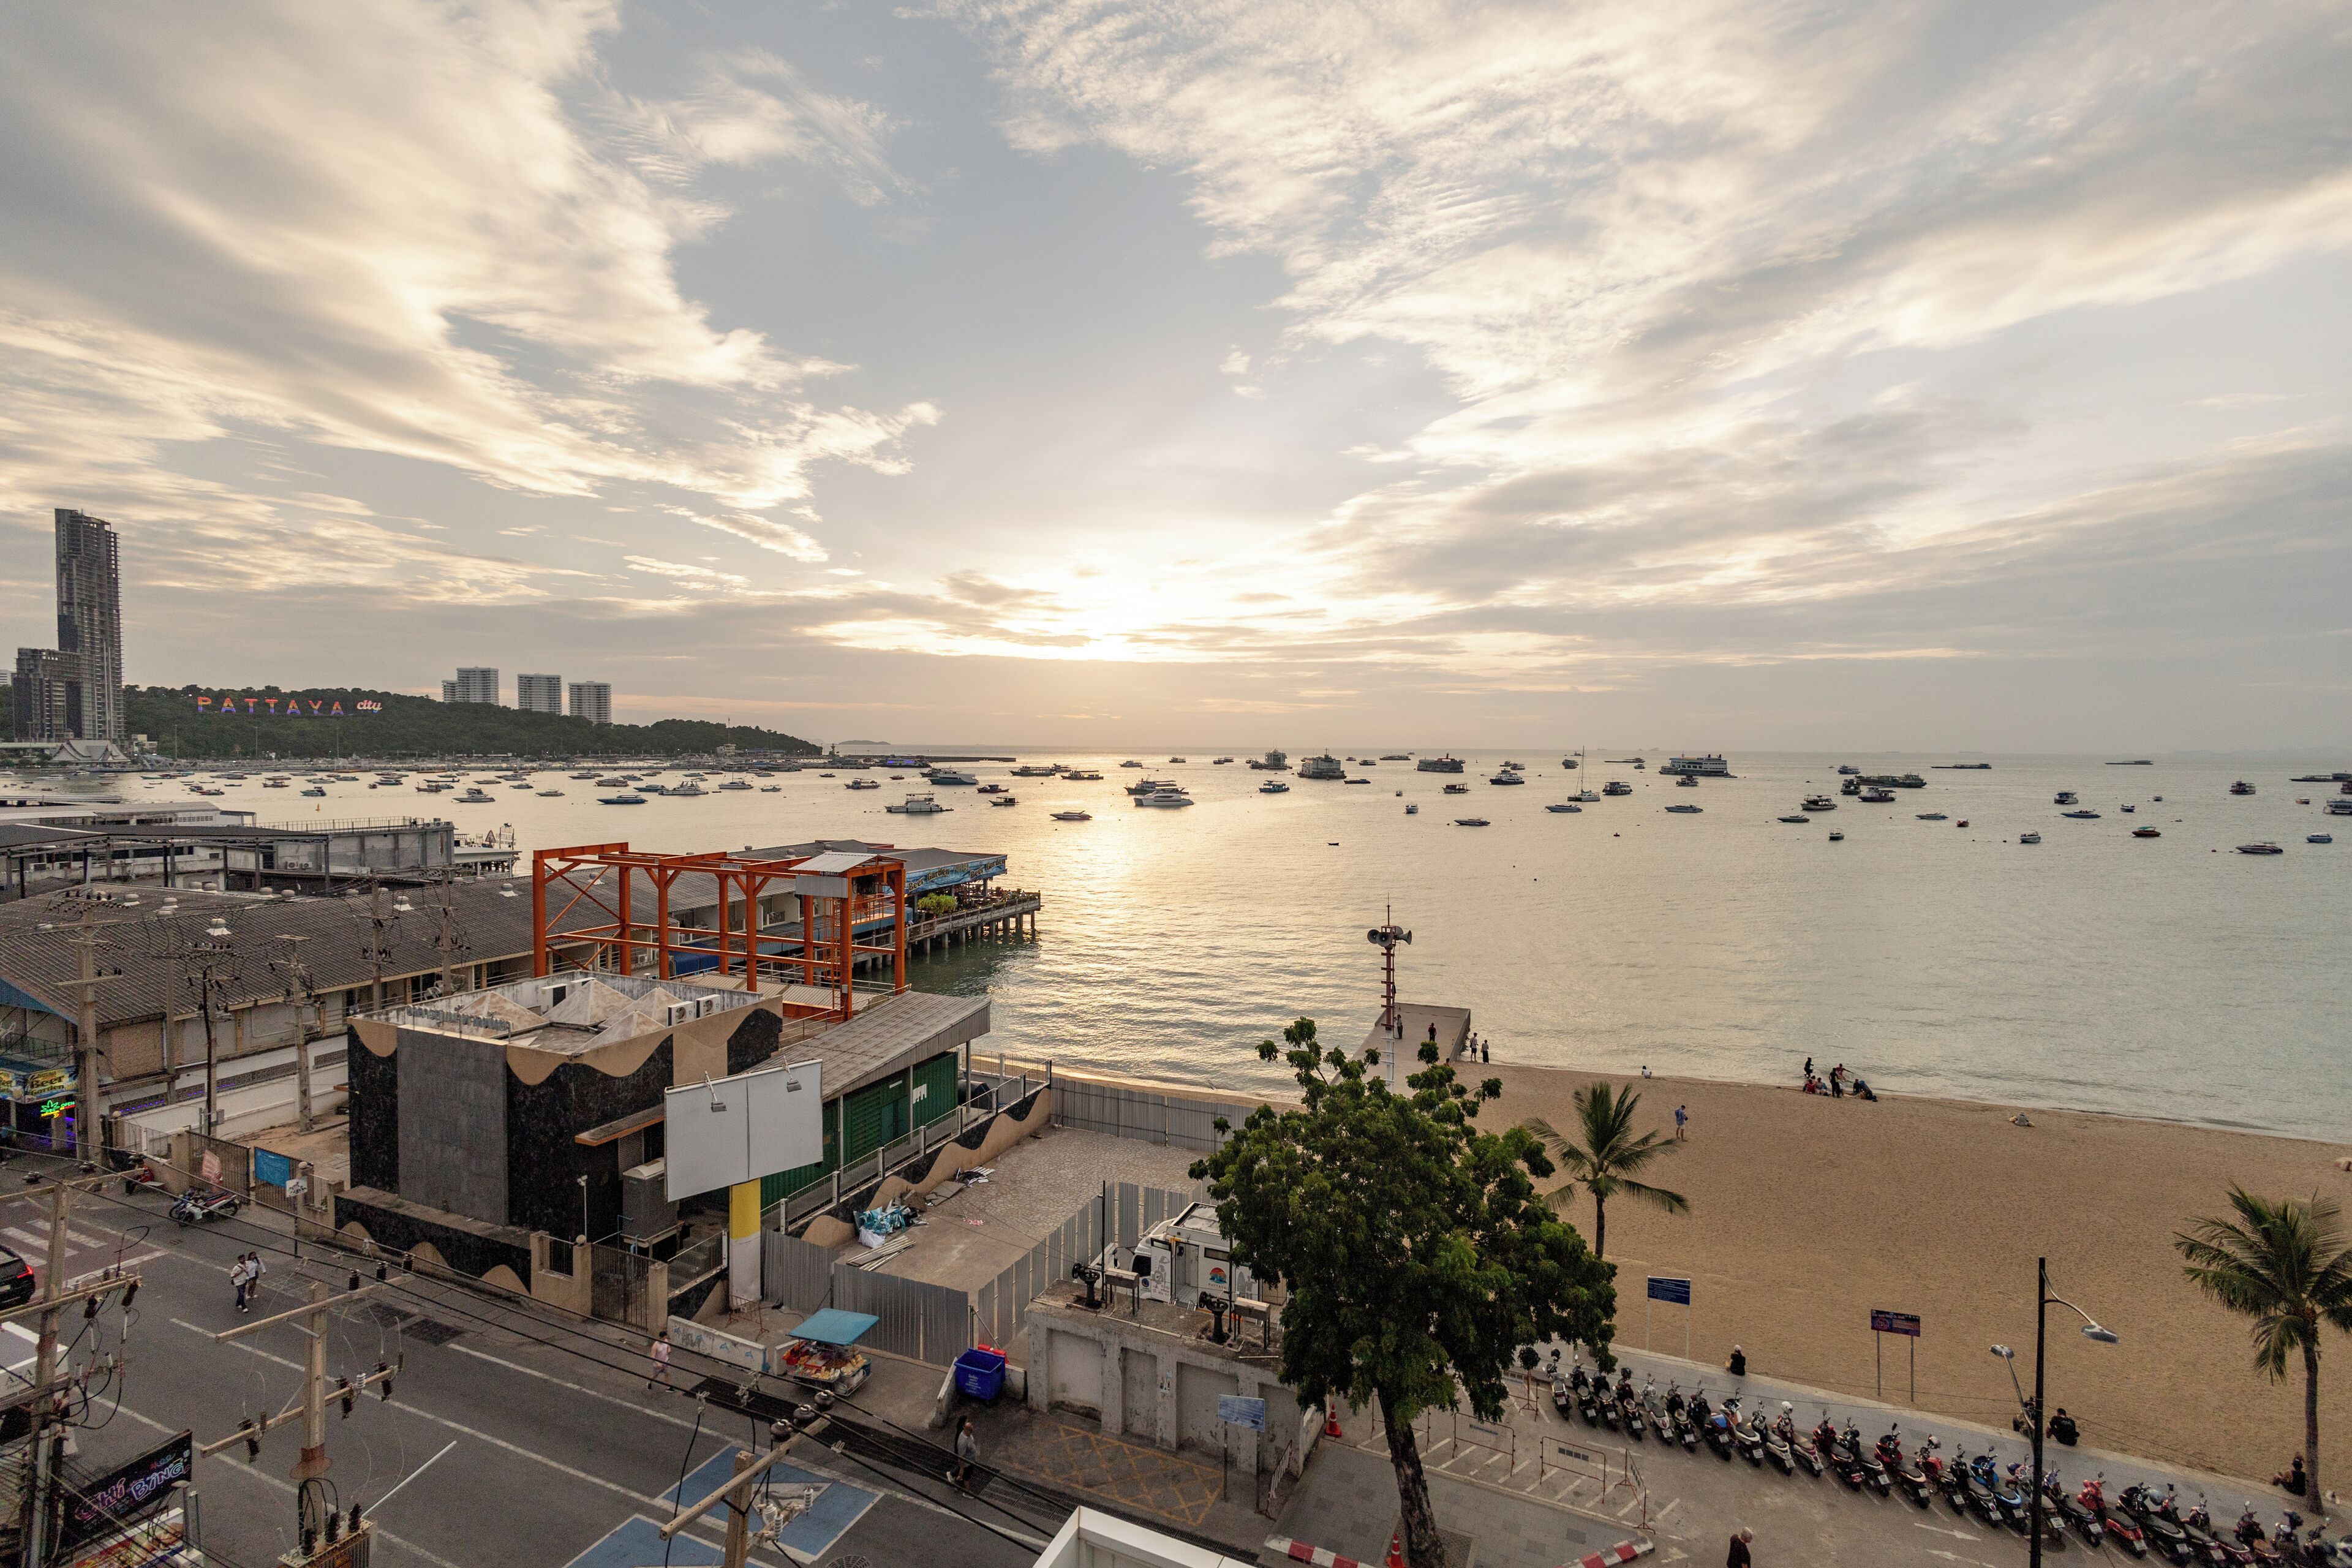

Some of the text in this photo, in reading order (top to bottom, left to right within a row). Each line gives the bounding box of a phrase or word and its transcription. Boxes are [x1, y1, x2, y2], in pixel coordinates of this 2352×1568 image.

[197, 696, 383, 715] PATTAYA city
[970, 859, 1006, 879] Beer Garden
[908, 867, 950, 892] Beer Garden
[31, 1075, 64, 1088] Beer
[31, 1085, 64, 1095] Garden
